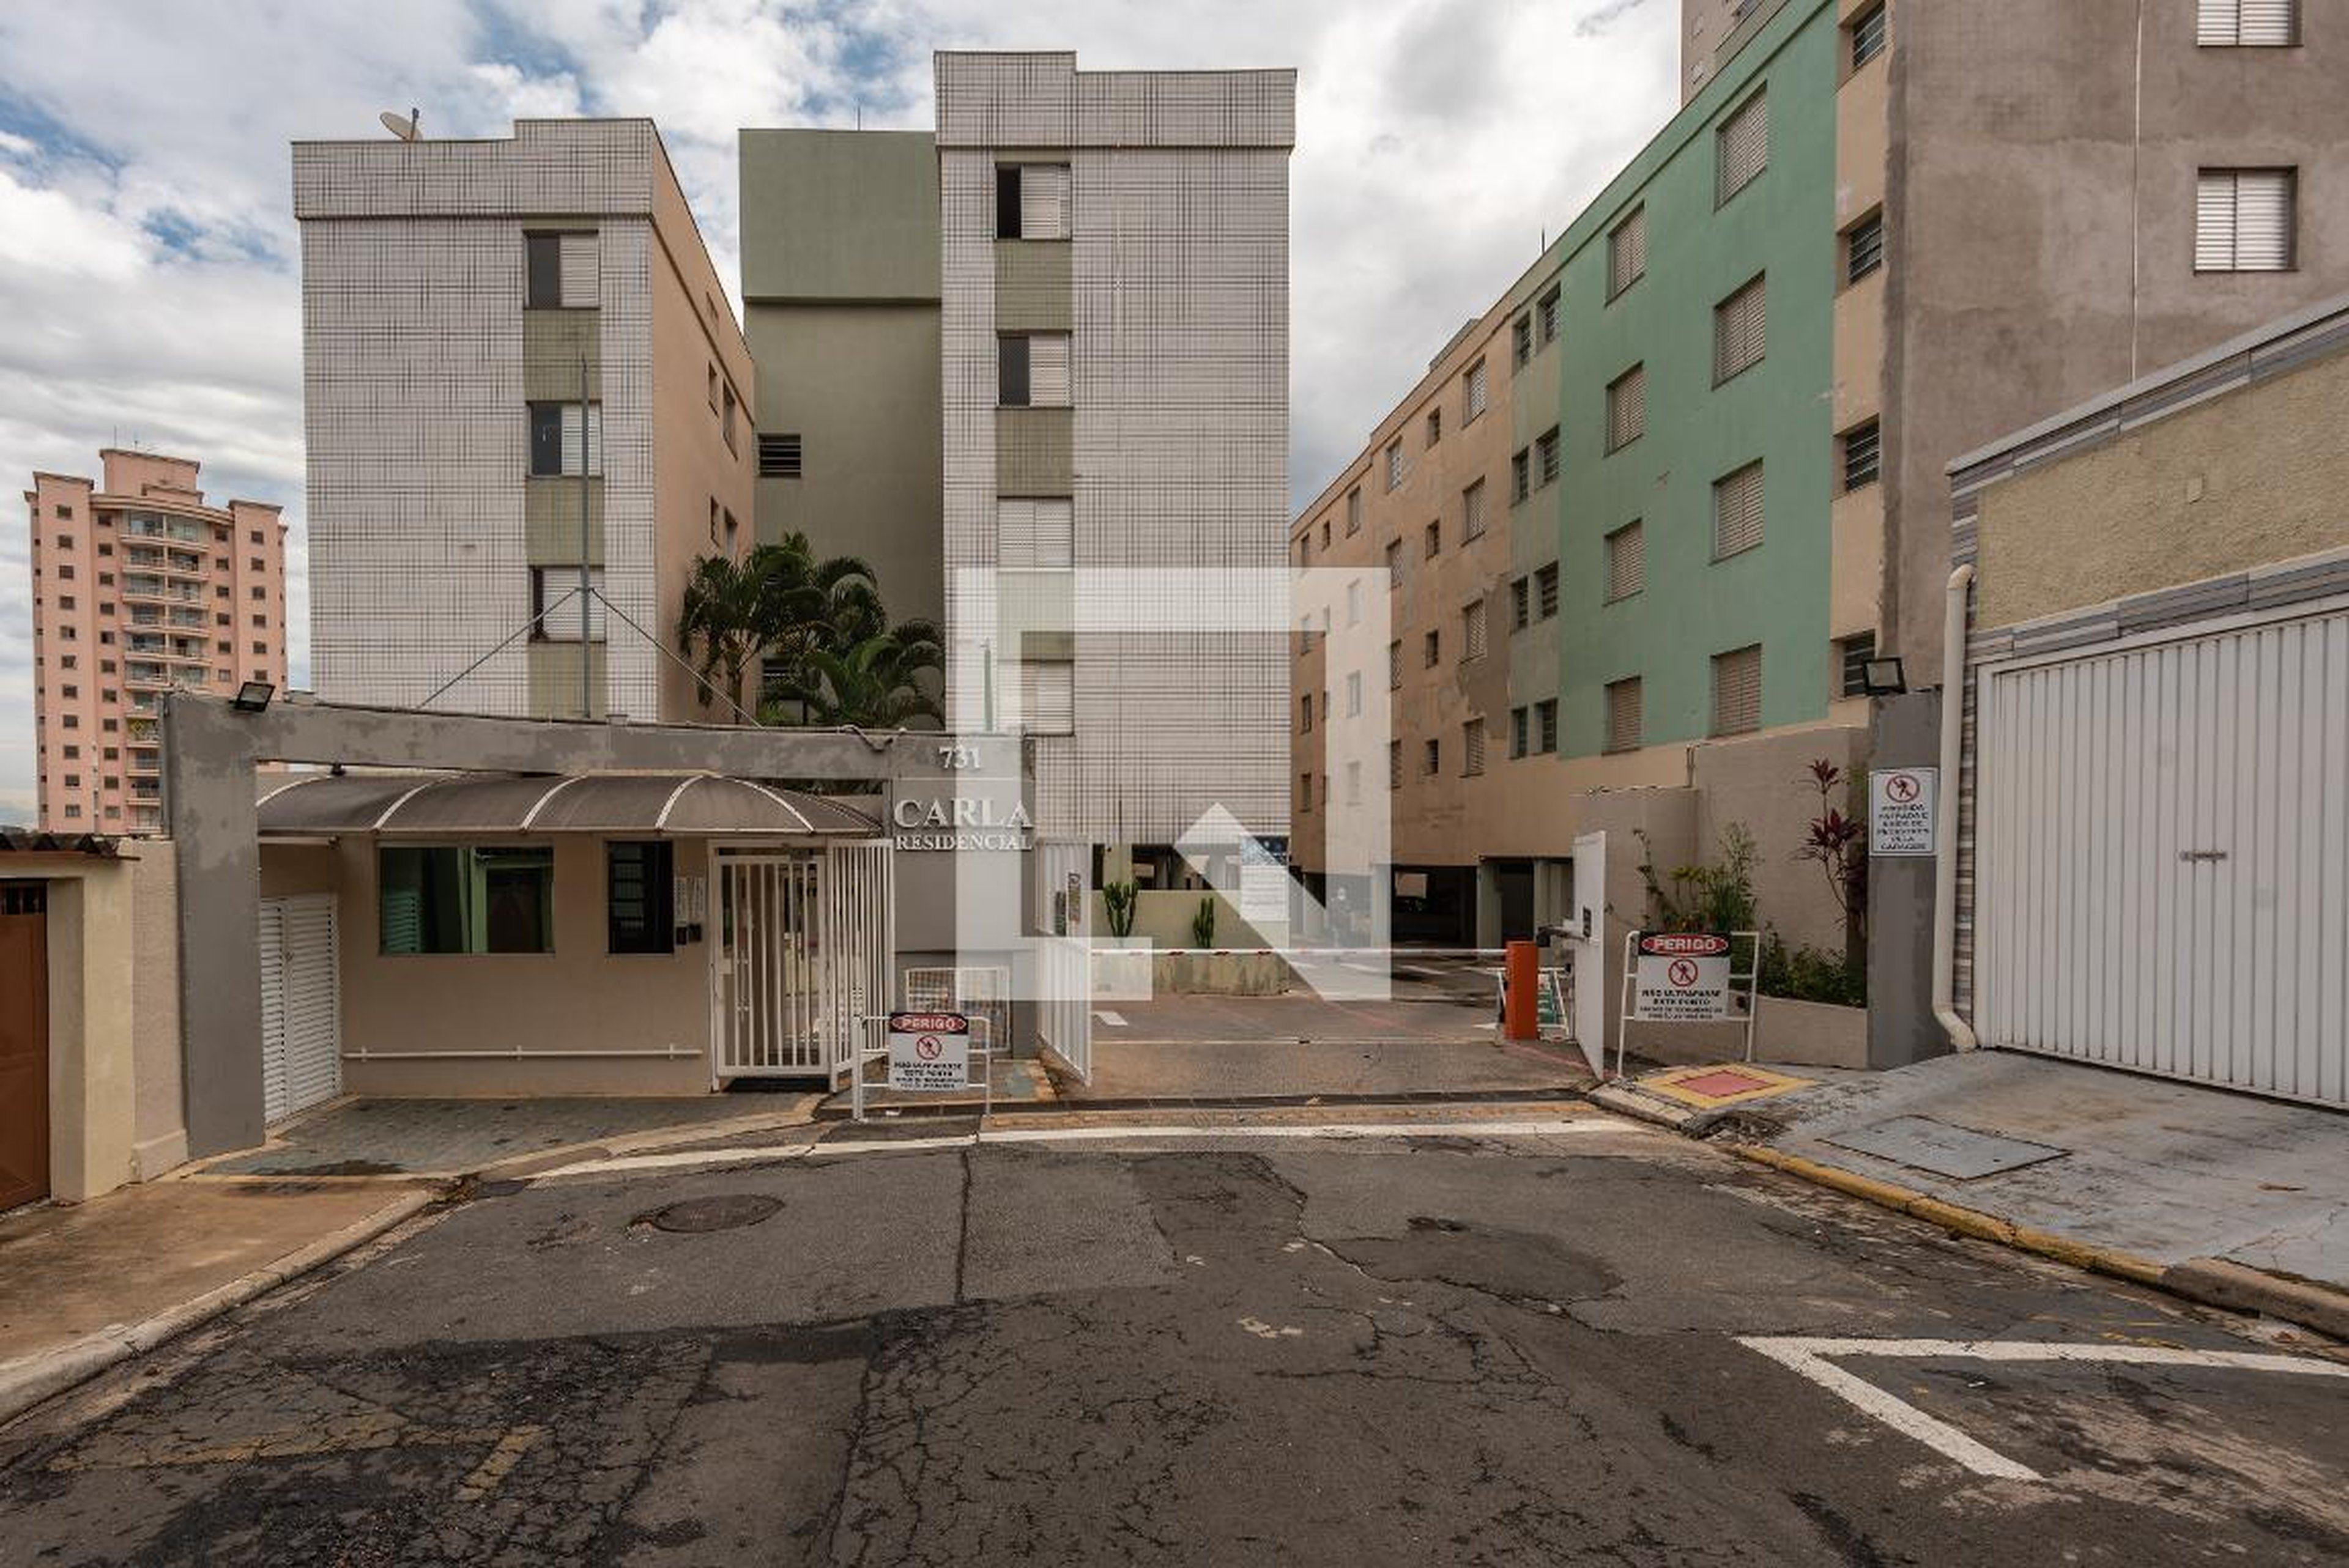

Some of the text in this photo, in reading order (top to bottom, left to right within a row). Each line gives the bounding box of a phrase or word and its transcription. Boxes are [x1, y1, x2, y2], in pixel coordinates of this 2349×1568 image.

[939, 747, 981, 769] 731
[894, 799, 1034, 828] CARLA
[896, 834, 1033, 850] RESIDENCIAL
[1654, 938, 1716, 950] PERIGO
[902, 1018, 956, 1030] PERIGO
